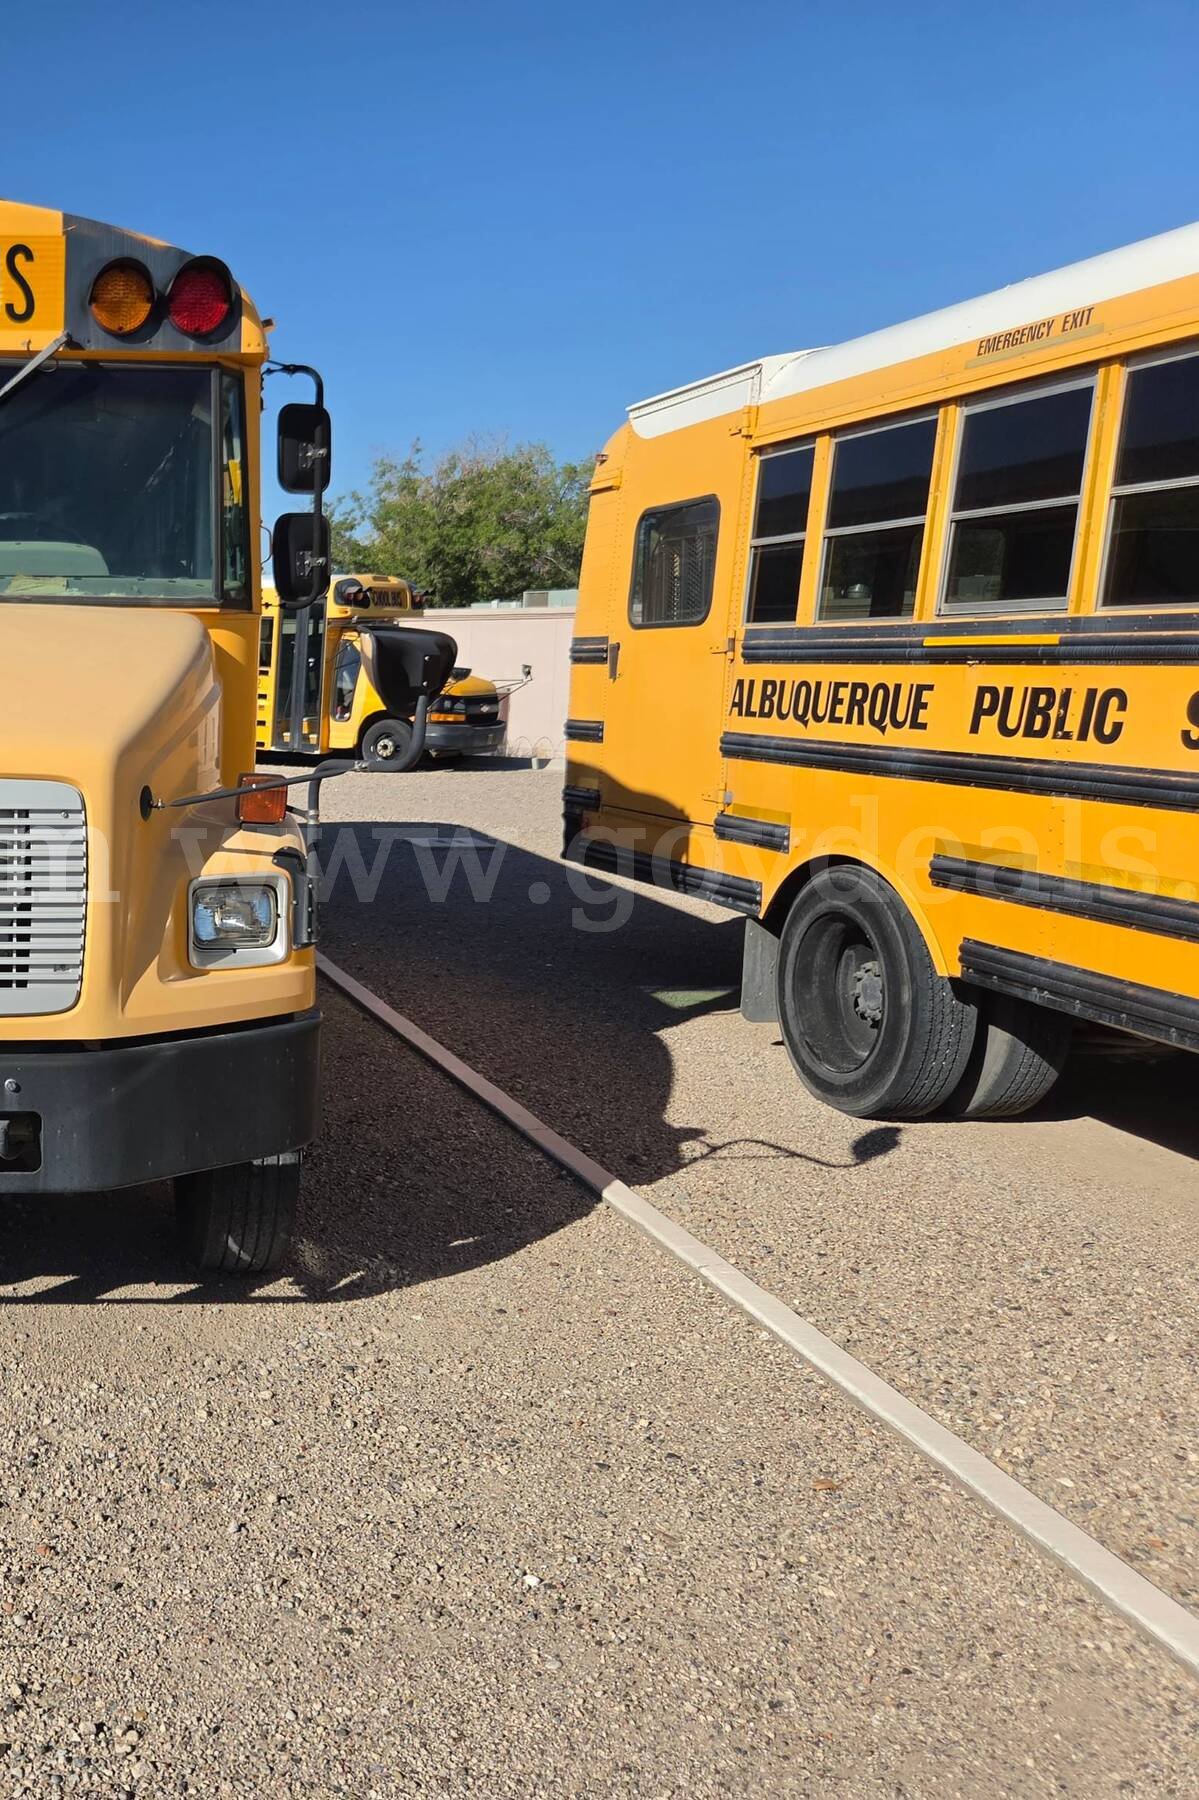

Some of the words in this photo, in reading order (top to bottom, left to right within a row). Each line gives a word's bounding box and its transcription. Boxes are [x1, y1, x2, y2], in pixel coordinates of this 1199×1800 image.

[977, 319, 1055, 356] EMERGENCY
[1061, 307, 1095, 333] EXIT
[729, 678, 935, 736] ALBUQUERQUE
[969, 685, 1128, 744] PUBLIC
